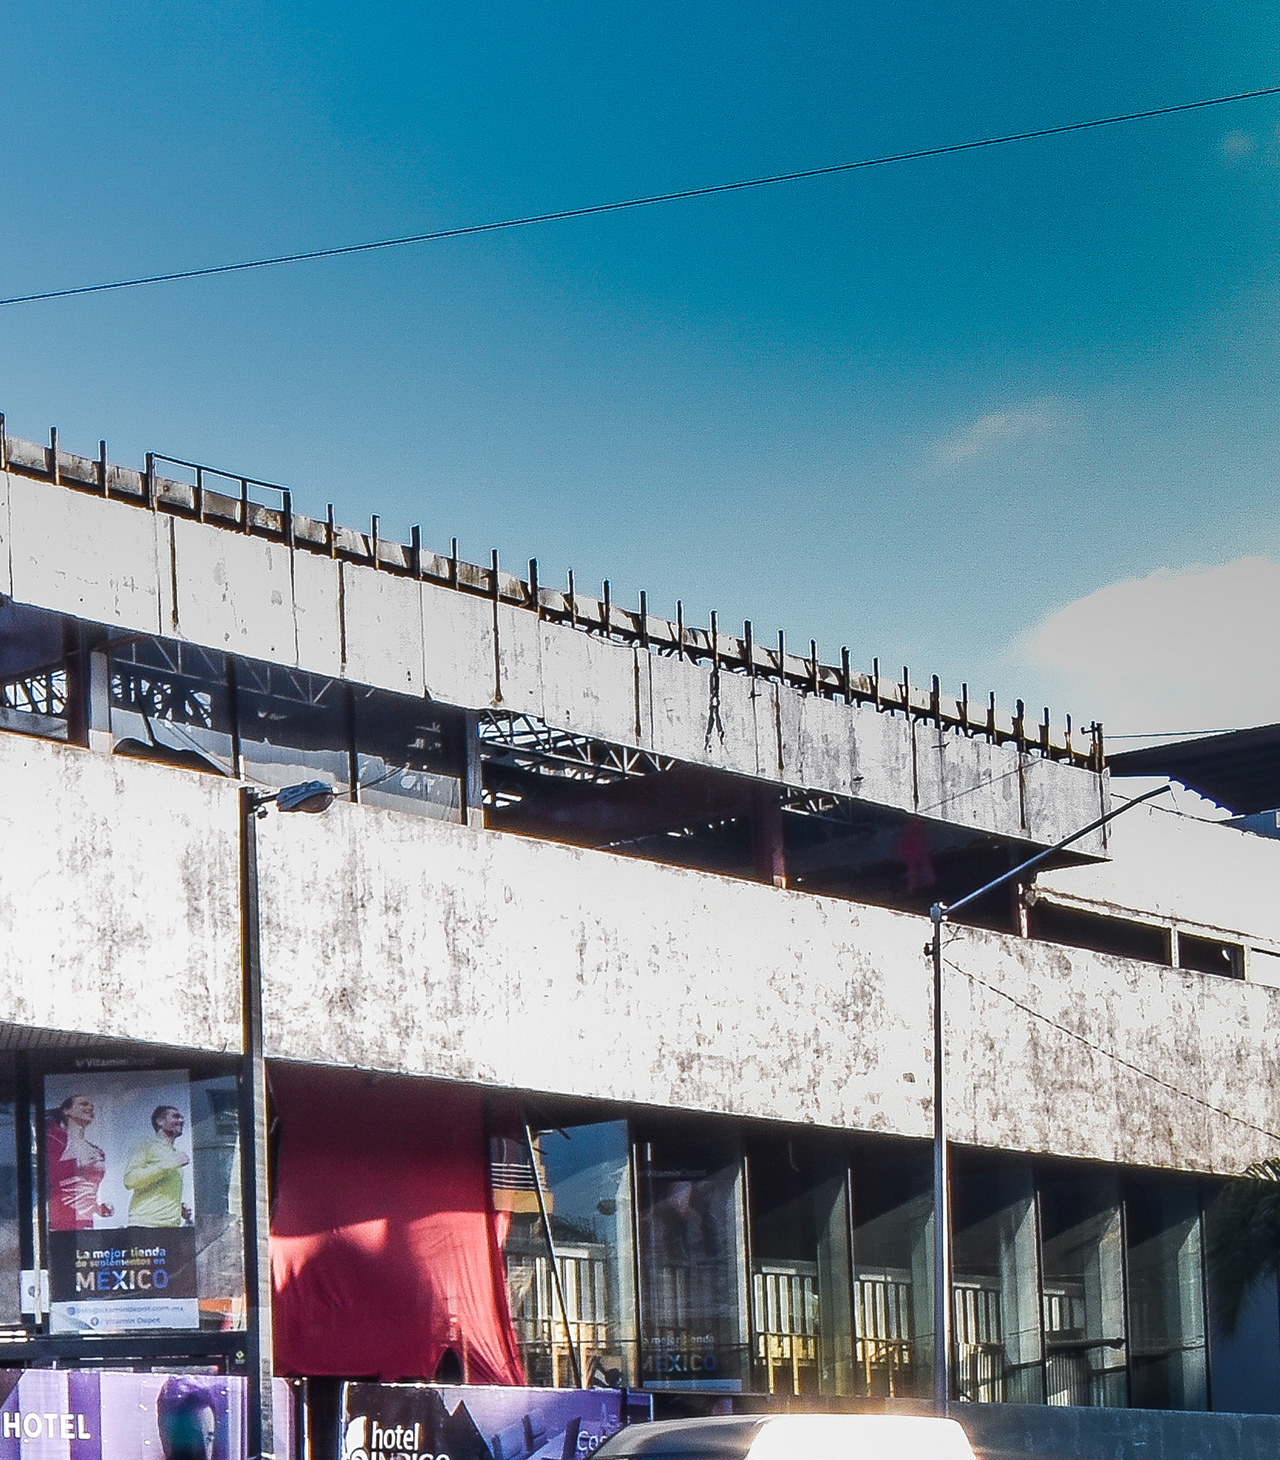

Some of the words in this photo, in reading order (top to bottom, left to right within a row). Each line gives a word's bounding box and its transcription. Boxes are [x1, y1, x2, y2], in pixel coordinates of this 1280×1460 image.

[93, 1248, 127, 1260] mejor
[131, 1246, 166, 1258] tienda
[3, 1411, 92, 1440] HOTEL
[371, 1420, 420, 1451] hotel
